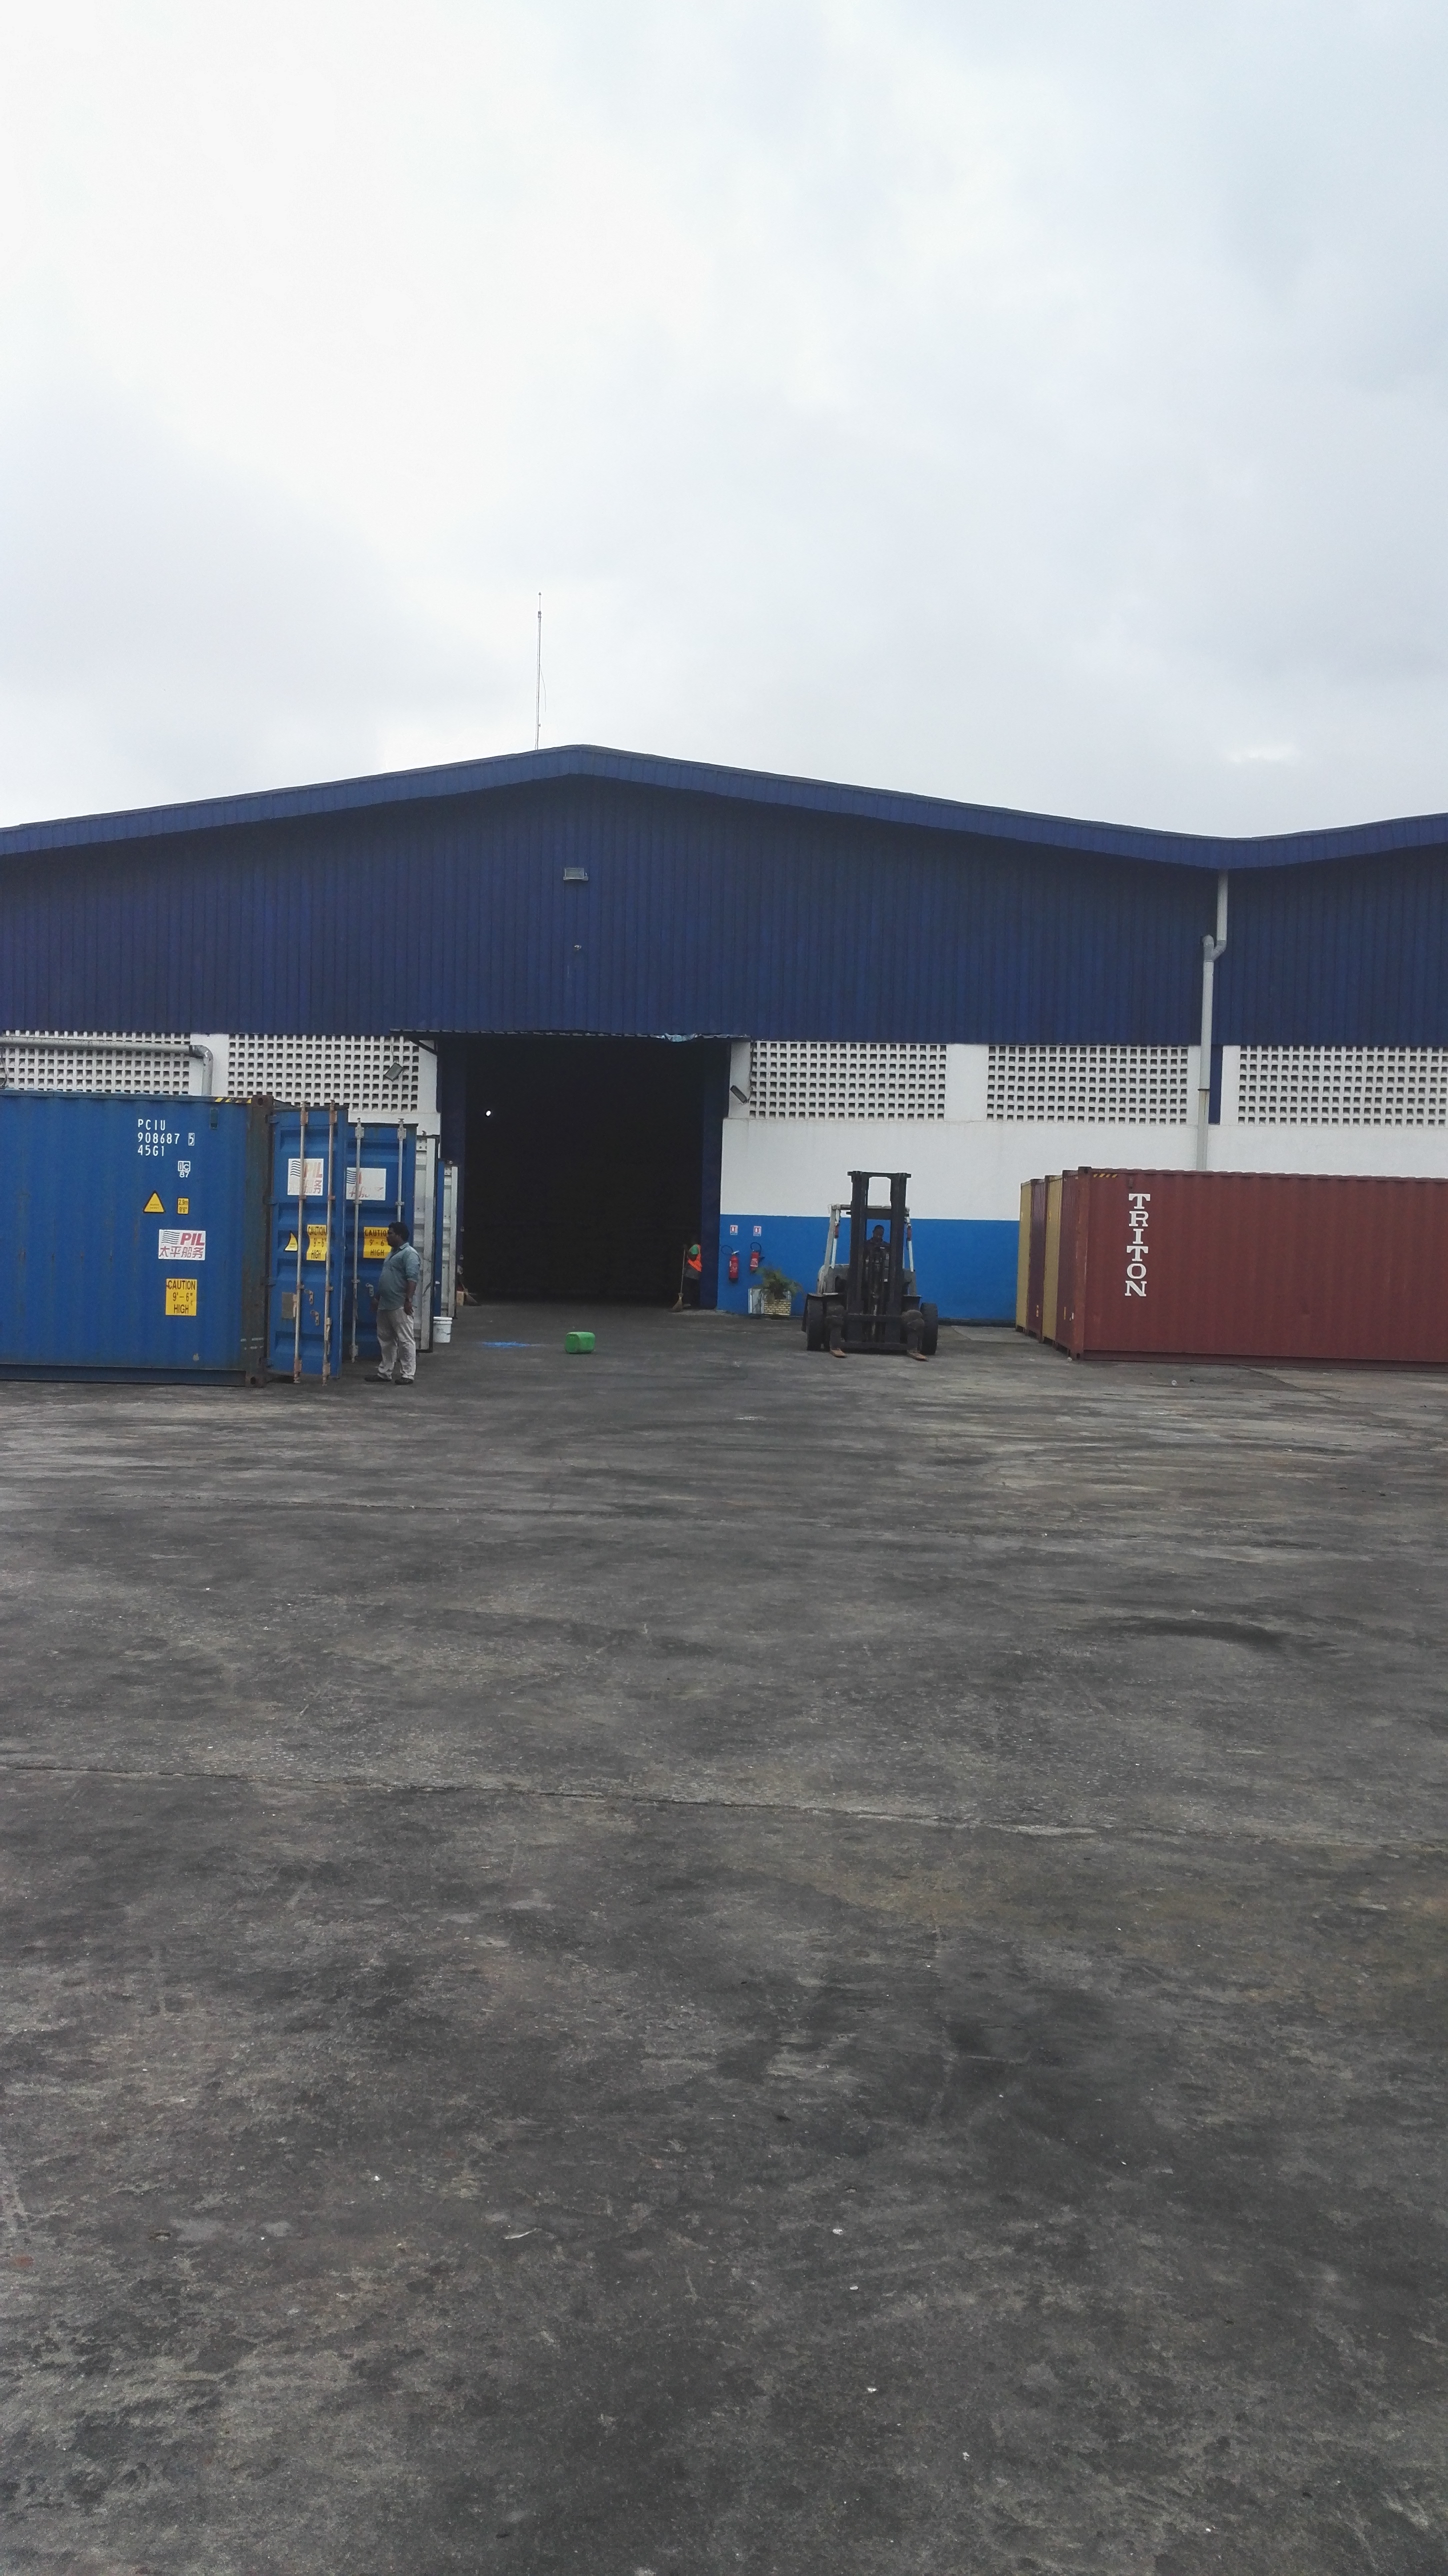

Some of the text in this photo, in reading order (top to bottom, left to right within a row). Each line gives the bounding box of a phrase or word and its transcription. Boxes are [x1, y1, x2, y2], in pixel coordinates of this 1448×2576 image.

[138, 1119, 166, 1131] PCIU
[138, 1132, 194, 1145] 908687 5
[138, 1145, 164, 1156] 45G1
[308, 1226, 326, 1236] CAUTION
[180, 1232, 205, 1246] PIL
[1125, 1193, 1150, 1296] TRITON
[159, 1246, 204, 1258] 太平船务
[311, 1250, 322, 1259] HIGH
[168, 1280, 196, 1290] CAUTION
[174, 1304, 189, 1314] HIGH
